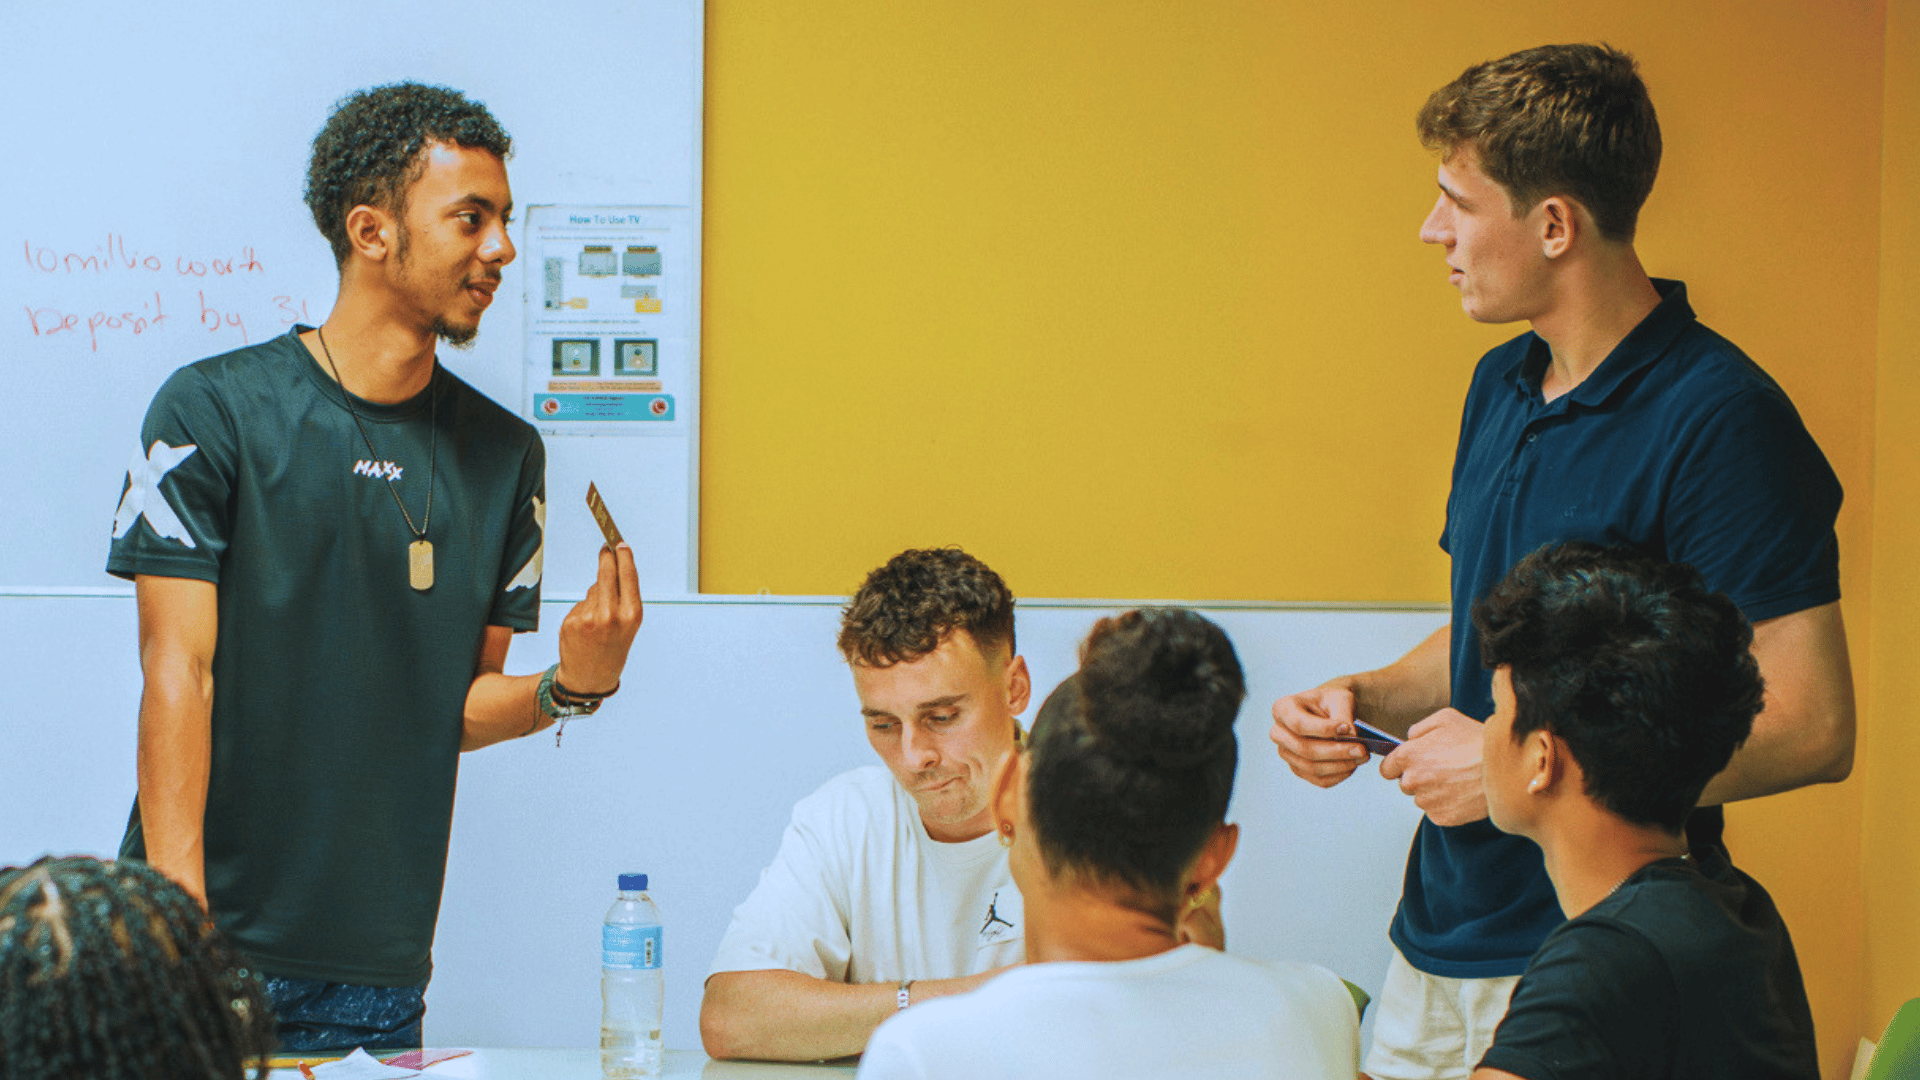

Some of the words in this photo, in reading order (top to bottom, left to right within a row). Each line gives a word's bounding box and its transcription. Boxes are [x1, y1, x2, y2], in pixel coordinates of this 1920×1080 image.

[569, 214, 591, 225] How
[594, 214, 606, 225] To
[609, 214, 626, 225] Use
[628, 214, 640, 225] TV
[24, 291, 169, 352] Deposit
[199, 290, 248, 345] by
